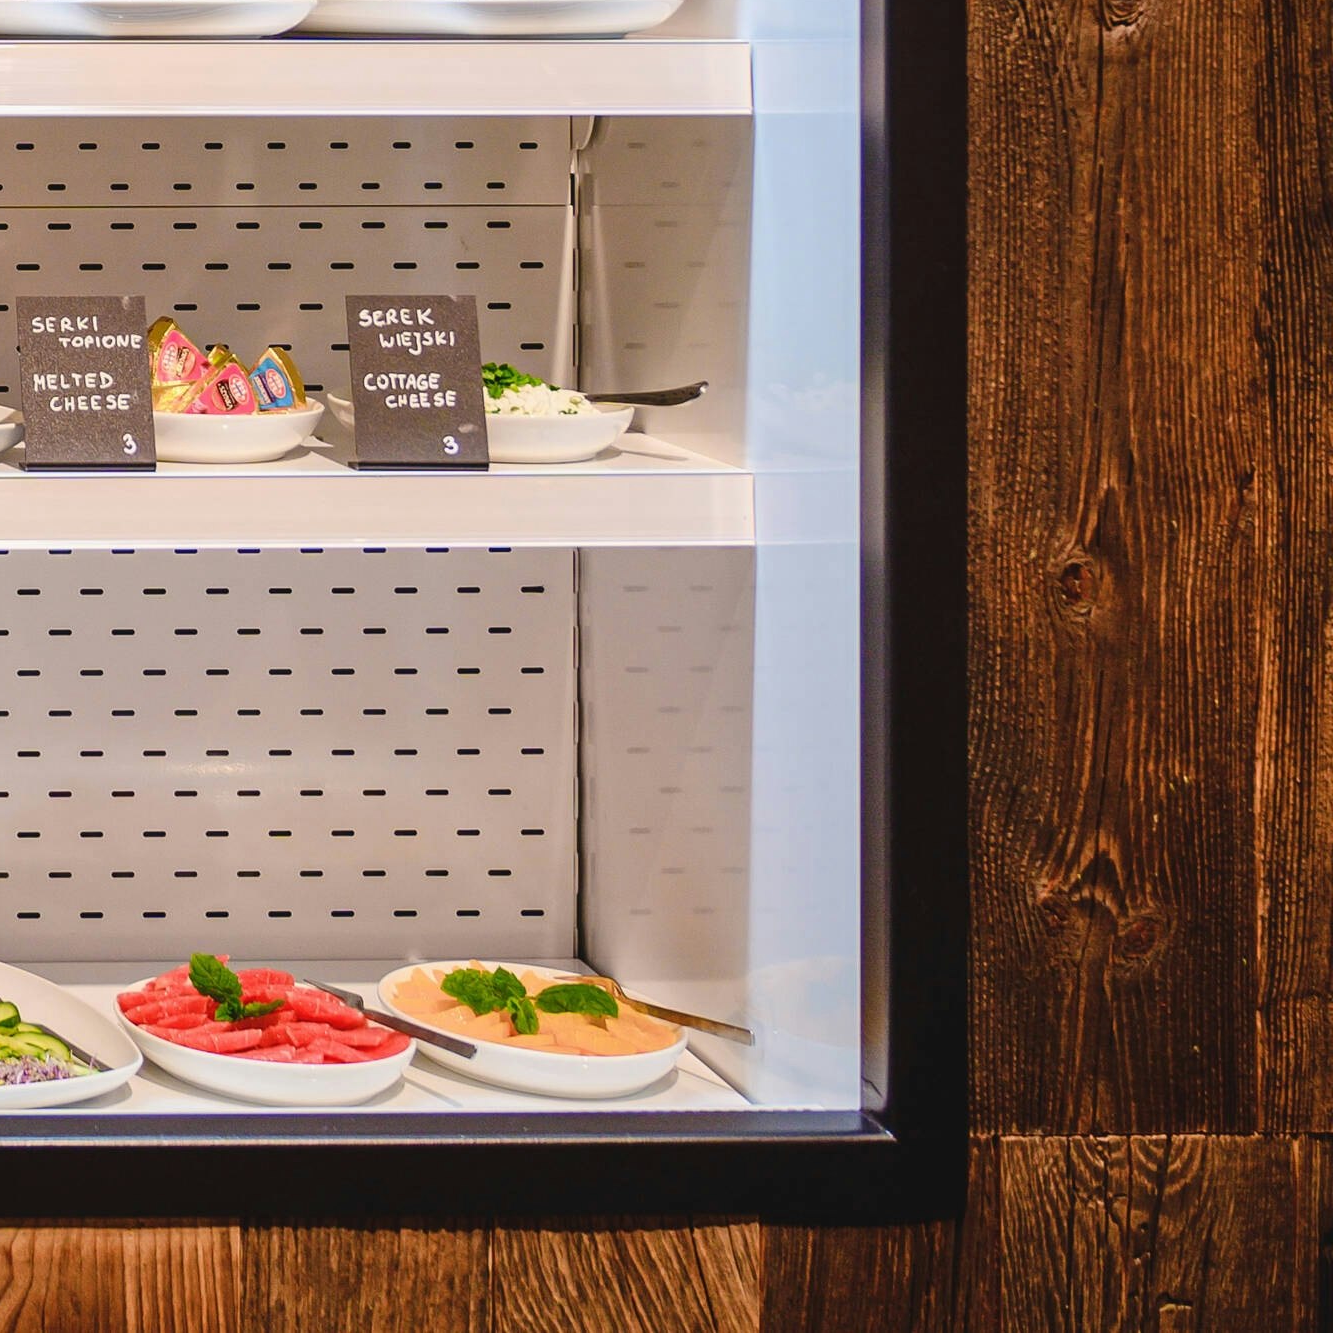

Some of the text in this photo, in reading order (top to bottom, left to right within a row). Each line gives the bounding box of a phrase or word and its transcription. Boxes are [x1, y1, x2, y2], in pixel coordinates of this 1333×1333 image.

[31, 316, 98, 333] SERKI
[358, 308, 435, 327] SEREK
[58, 334, 143, 349] TOPIONE
[379, 330, 455, 355] WIEJSKI
[33, 371, 114, 393] MELTED
[363, 372, 441, 391] COTTAGE
[49, 393, 131, 413] CHEESE
[385, 390, 457, 409] CHEESE
[122, 433, 138, 455] 3
[442, 435, 459, 455] 3
